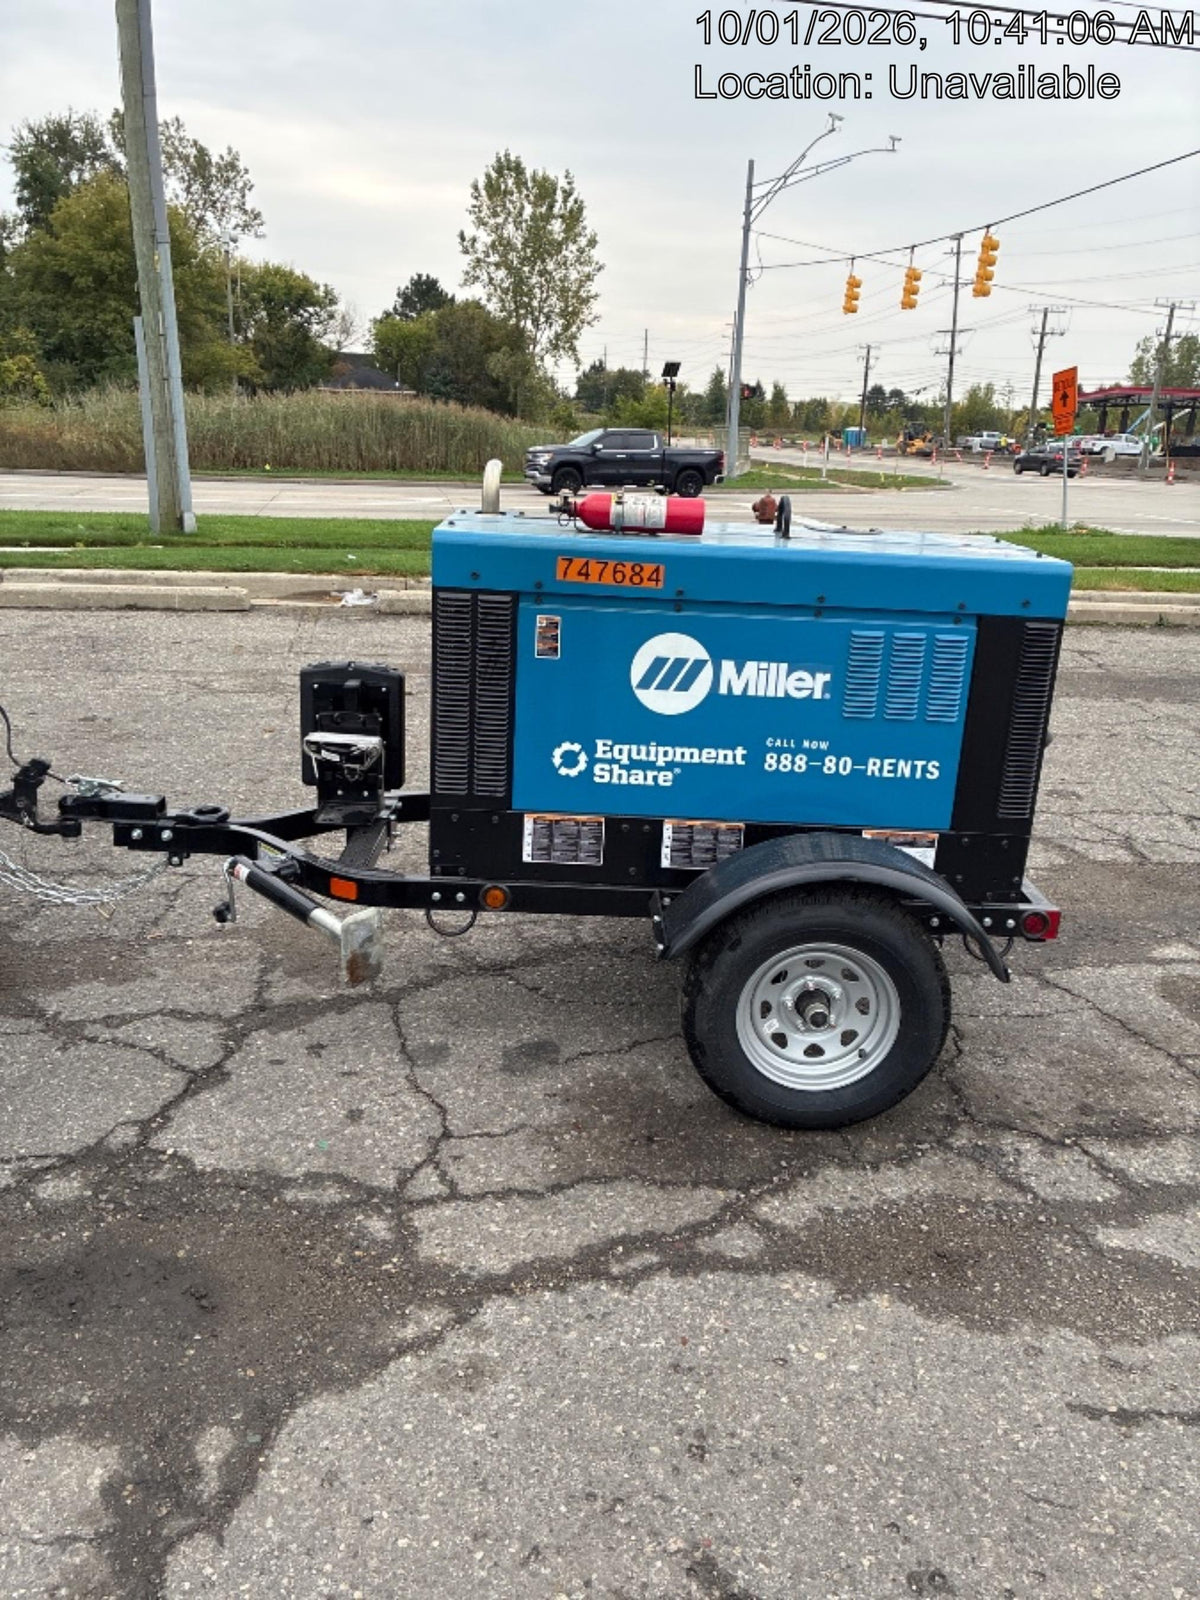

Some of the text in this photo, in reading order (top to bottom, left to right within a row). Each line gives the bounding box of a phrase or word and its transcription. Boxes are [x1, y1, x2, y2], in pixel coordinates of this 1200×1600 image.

[561, 558, 661, 587] 747684
[718, 659, 832, 700] Miller
[595, 739, 747, 766] Equipment
[766, 737, 830, 751] CALL NOW
[764, 752, 940, 780] 888-80-RENTS
